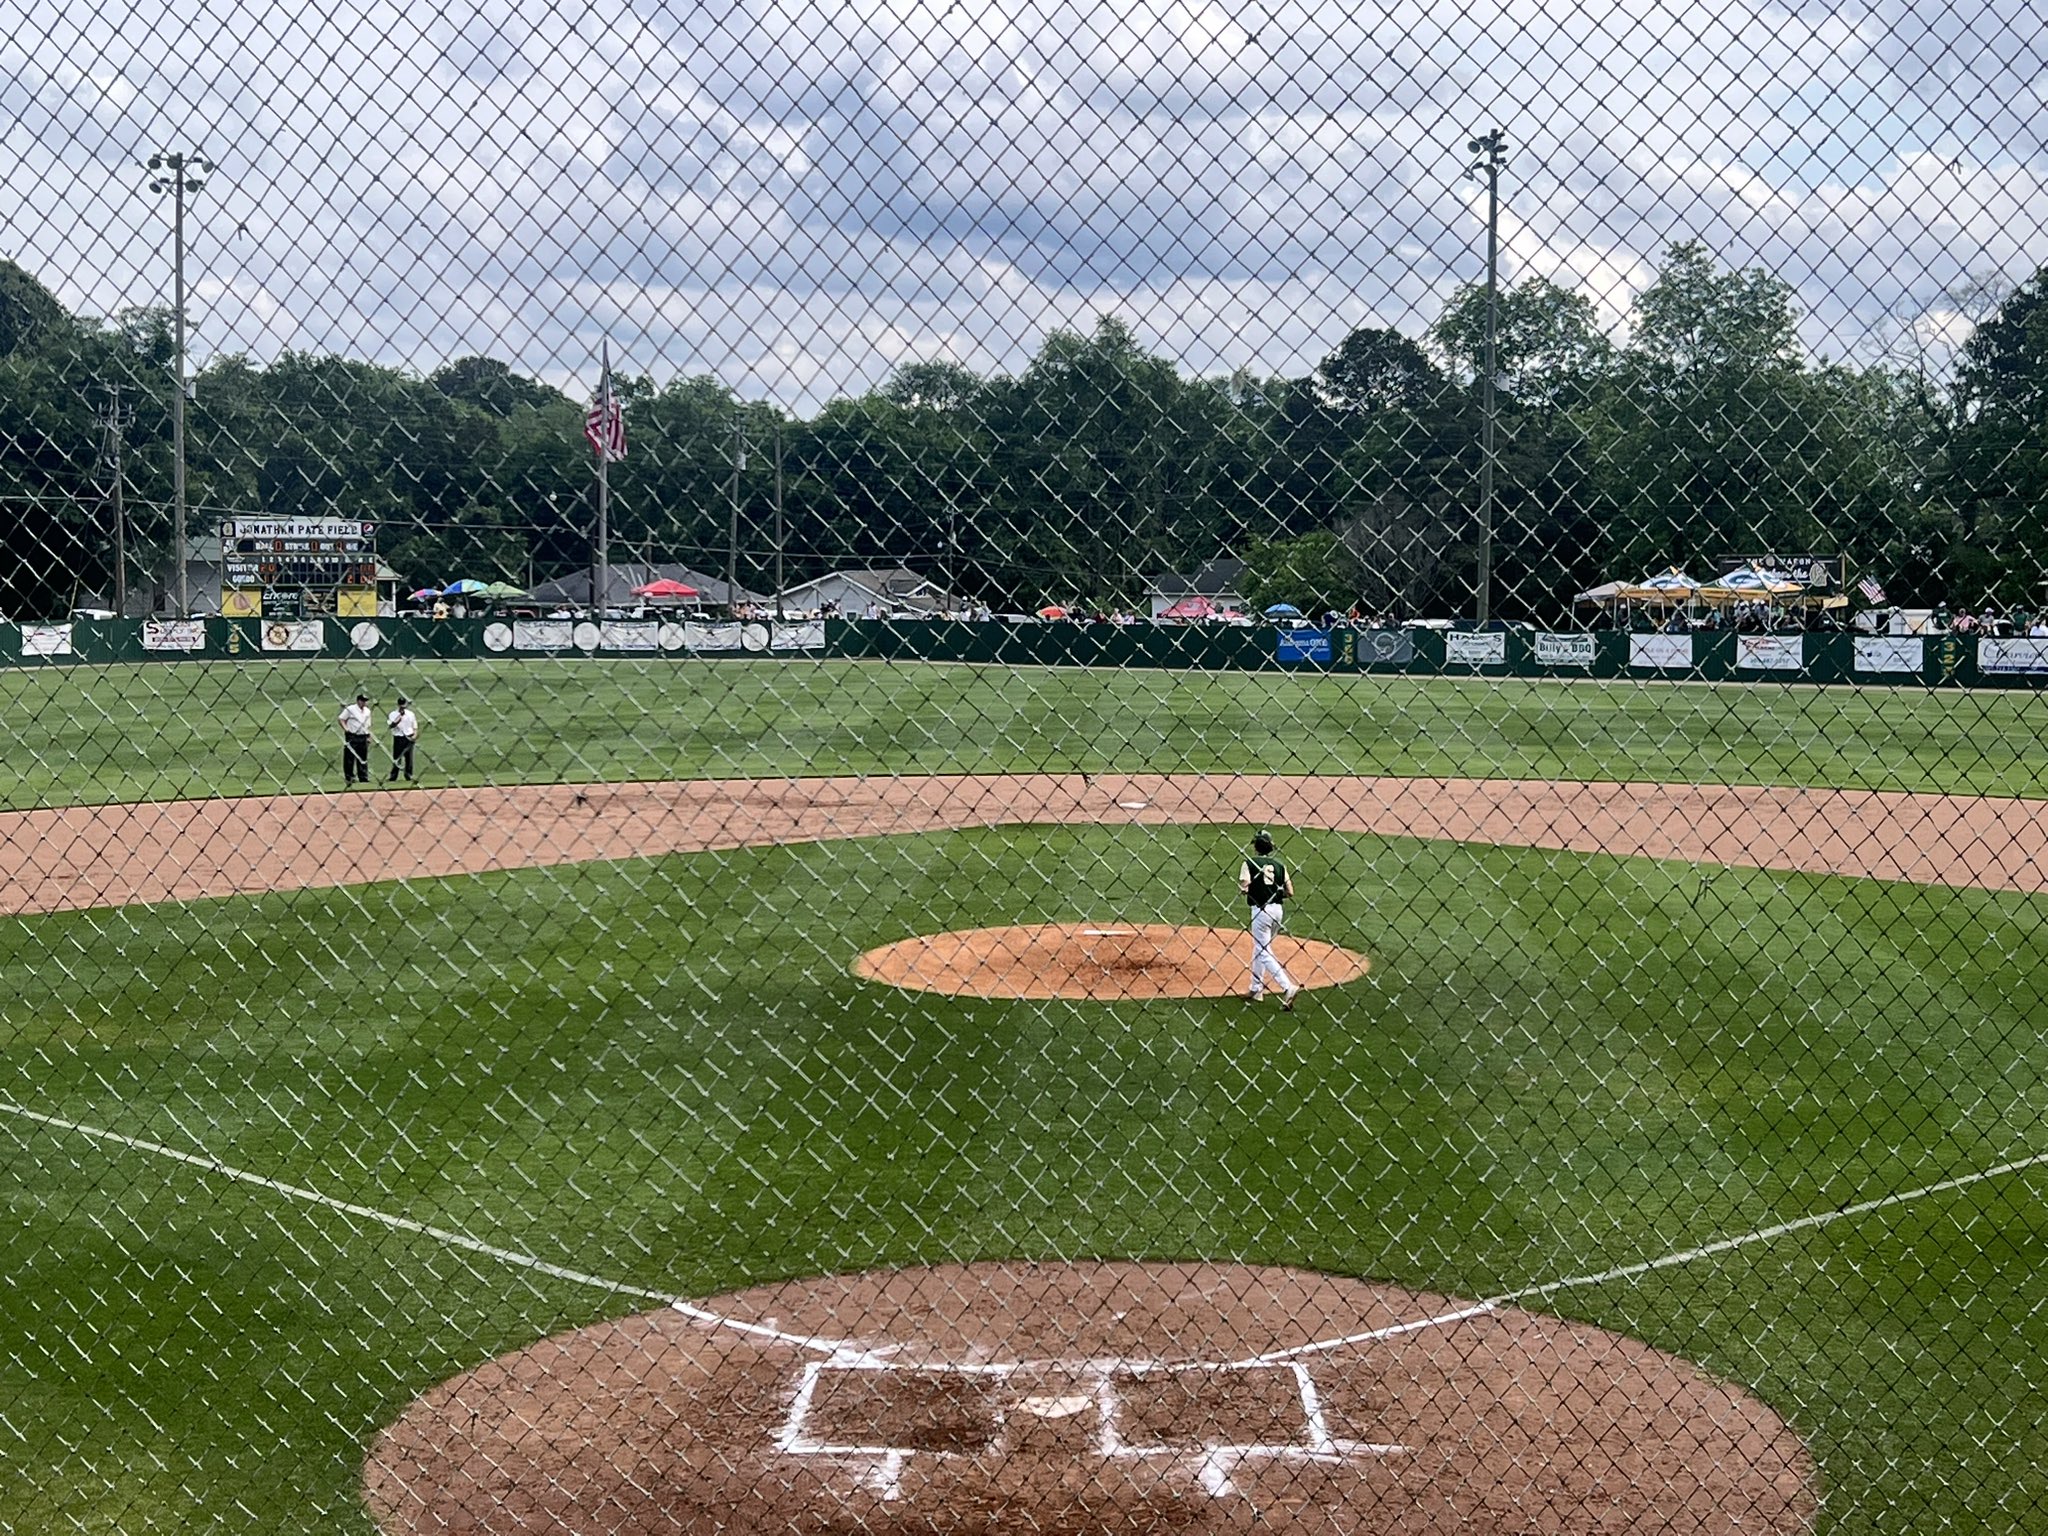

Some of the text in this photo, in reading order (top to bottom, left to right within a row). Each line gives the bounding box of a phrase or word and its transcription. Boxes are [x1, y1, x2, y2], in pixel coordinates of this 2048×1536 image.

[239, 524, 358, 535] JONATHAN PATE FIELD
